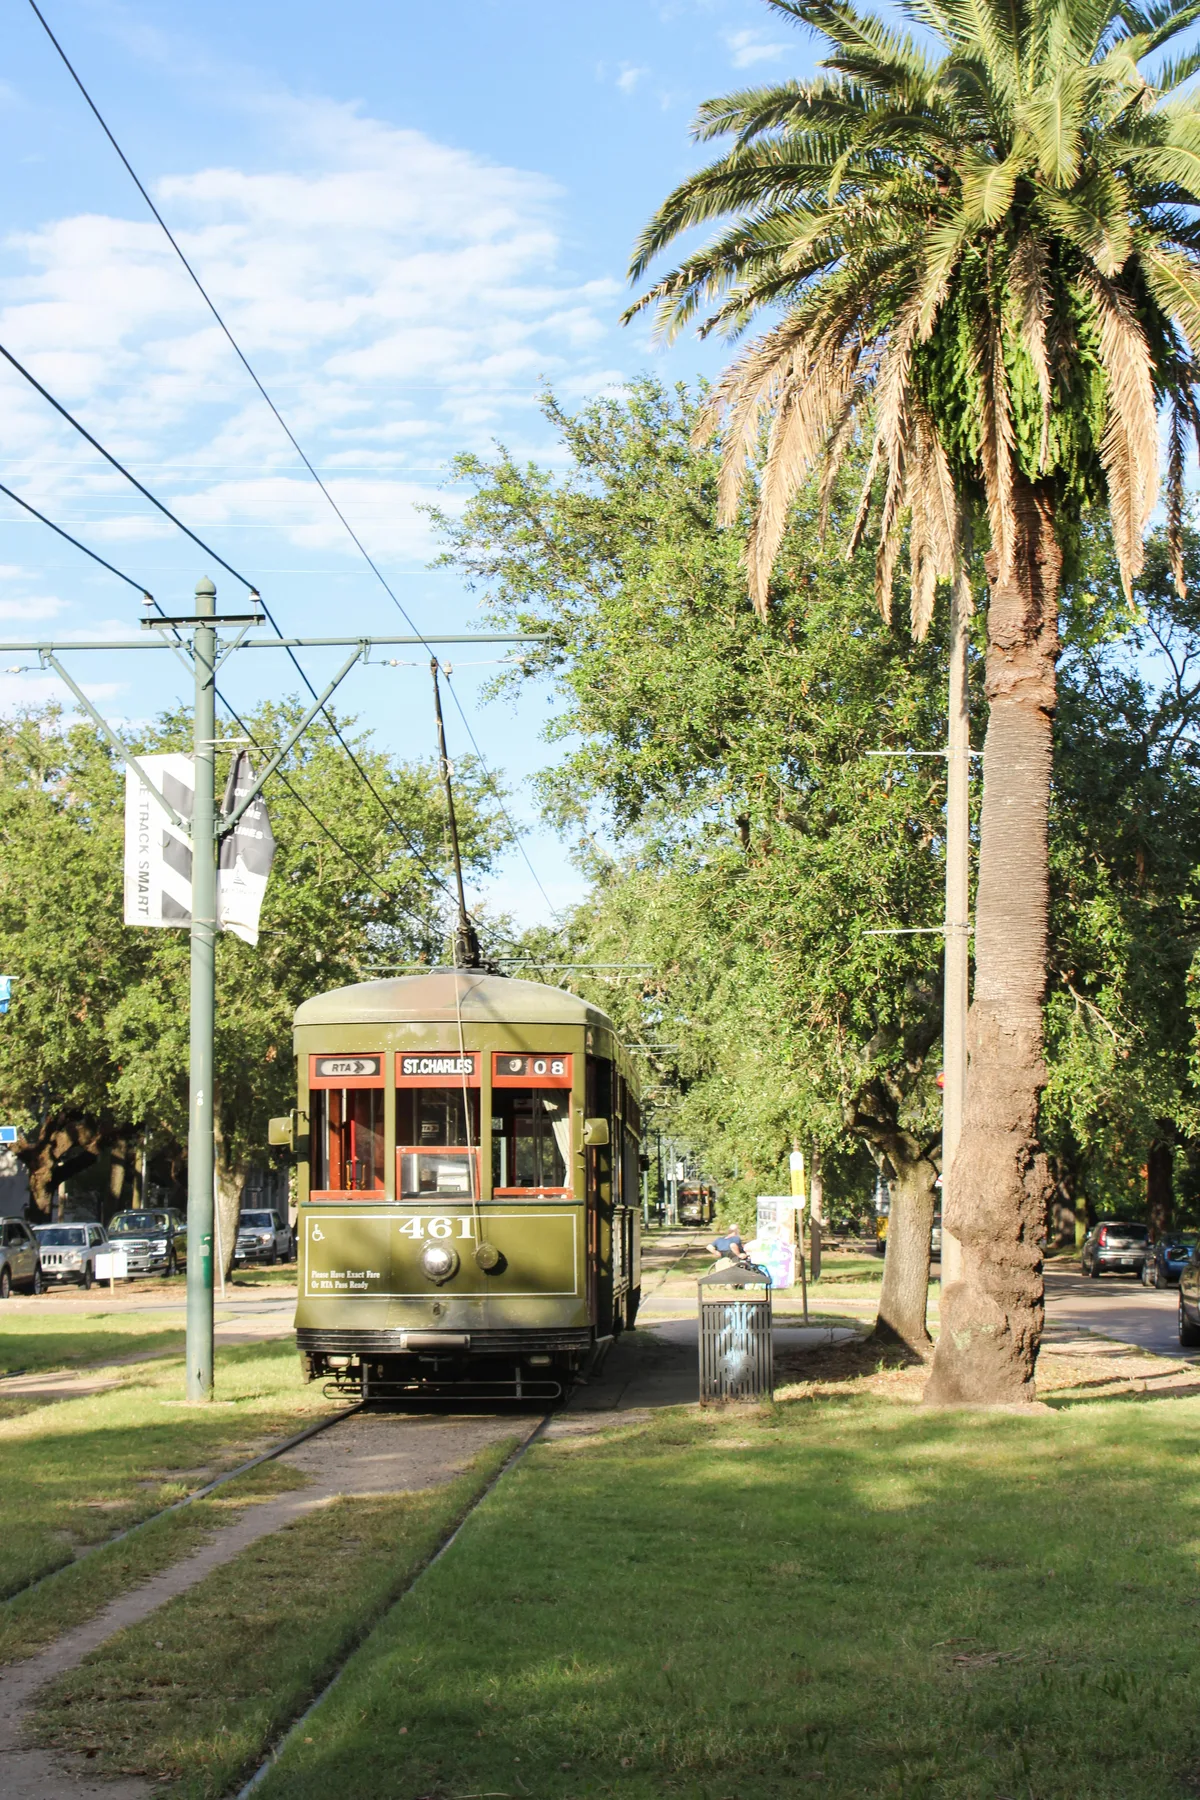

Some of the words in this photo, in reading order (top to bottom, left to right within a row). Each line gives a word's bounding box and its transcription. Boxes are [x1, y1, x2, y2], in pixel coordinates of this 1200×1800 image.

[138, 802, 150, 855] TRACK
[137, 860, 150, 916] SMART
[331, 1063, 352, 1072] RTA
[399, 1217, 476, 1239] 461
[311, 1270, 329, 1279] Please
[330, 1270, 345, 1279] Have
[346, 1270, 365, 1279] Exact
[366, 1270, 381, 1279] Fare
[311, 1280, 319, 1289] Or
[320, 1280, 333, 1289] RTA
[334, 1280, 348, 1289] Pass
[349, 1280, 369, 1290] Ready
